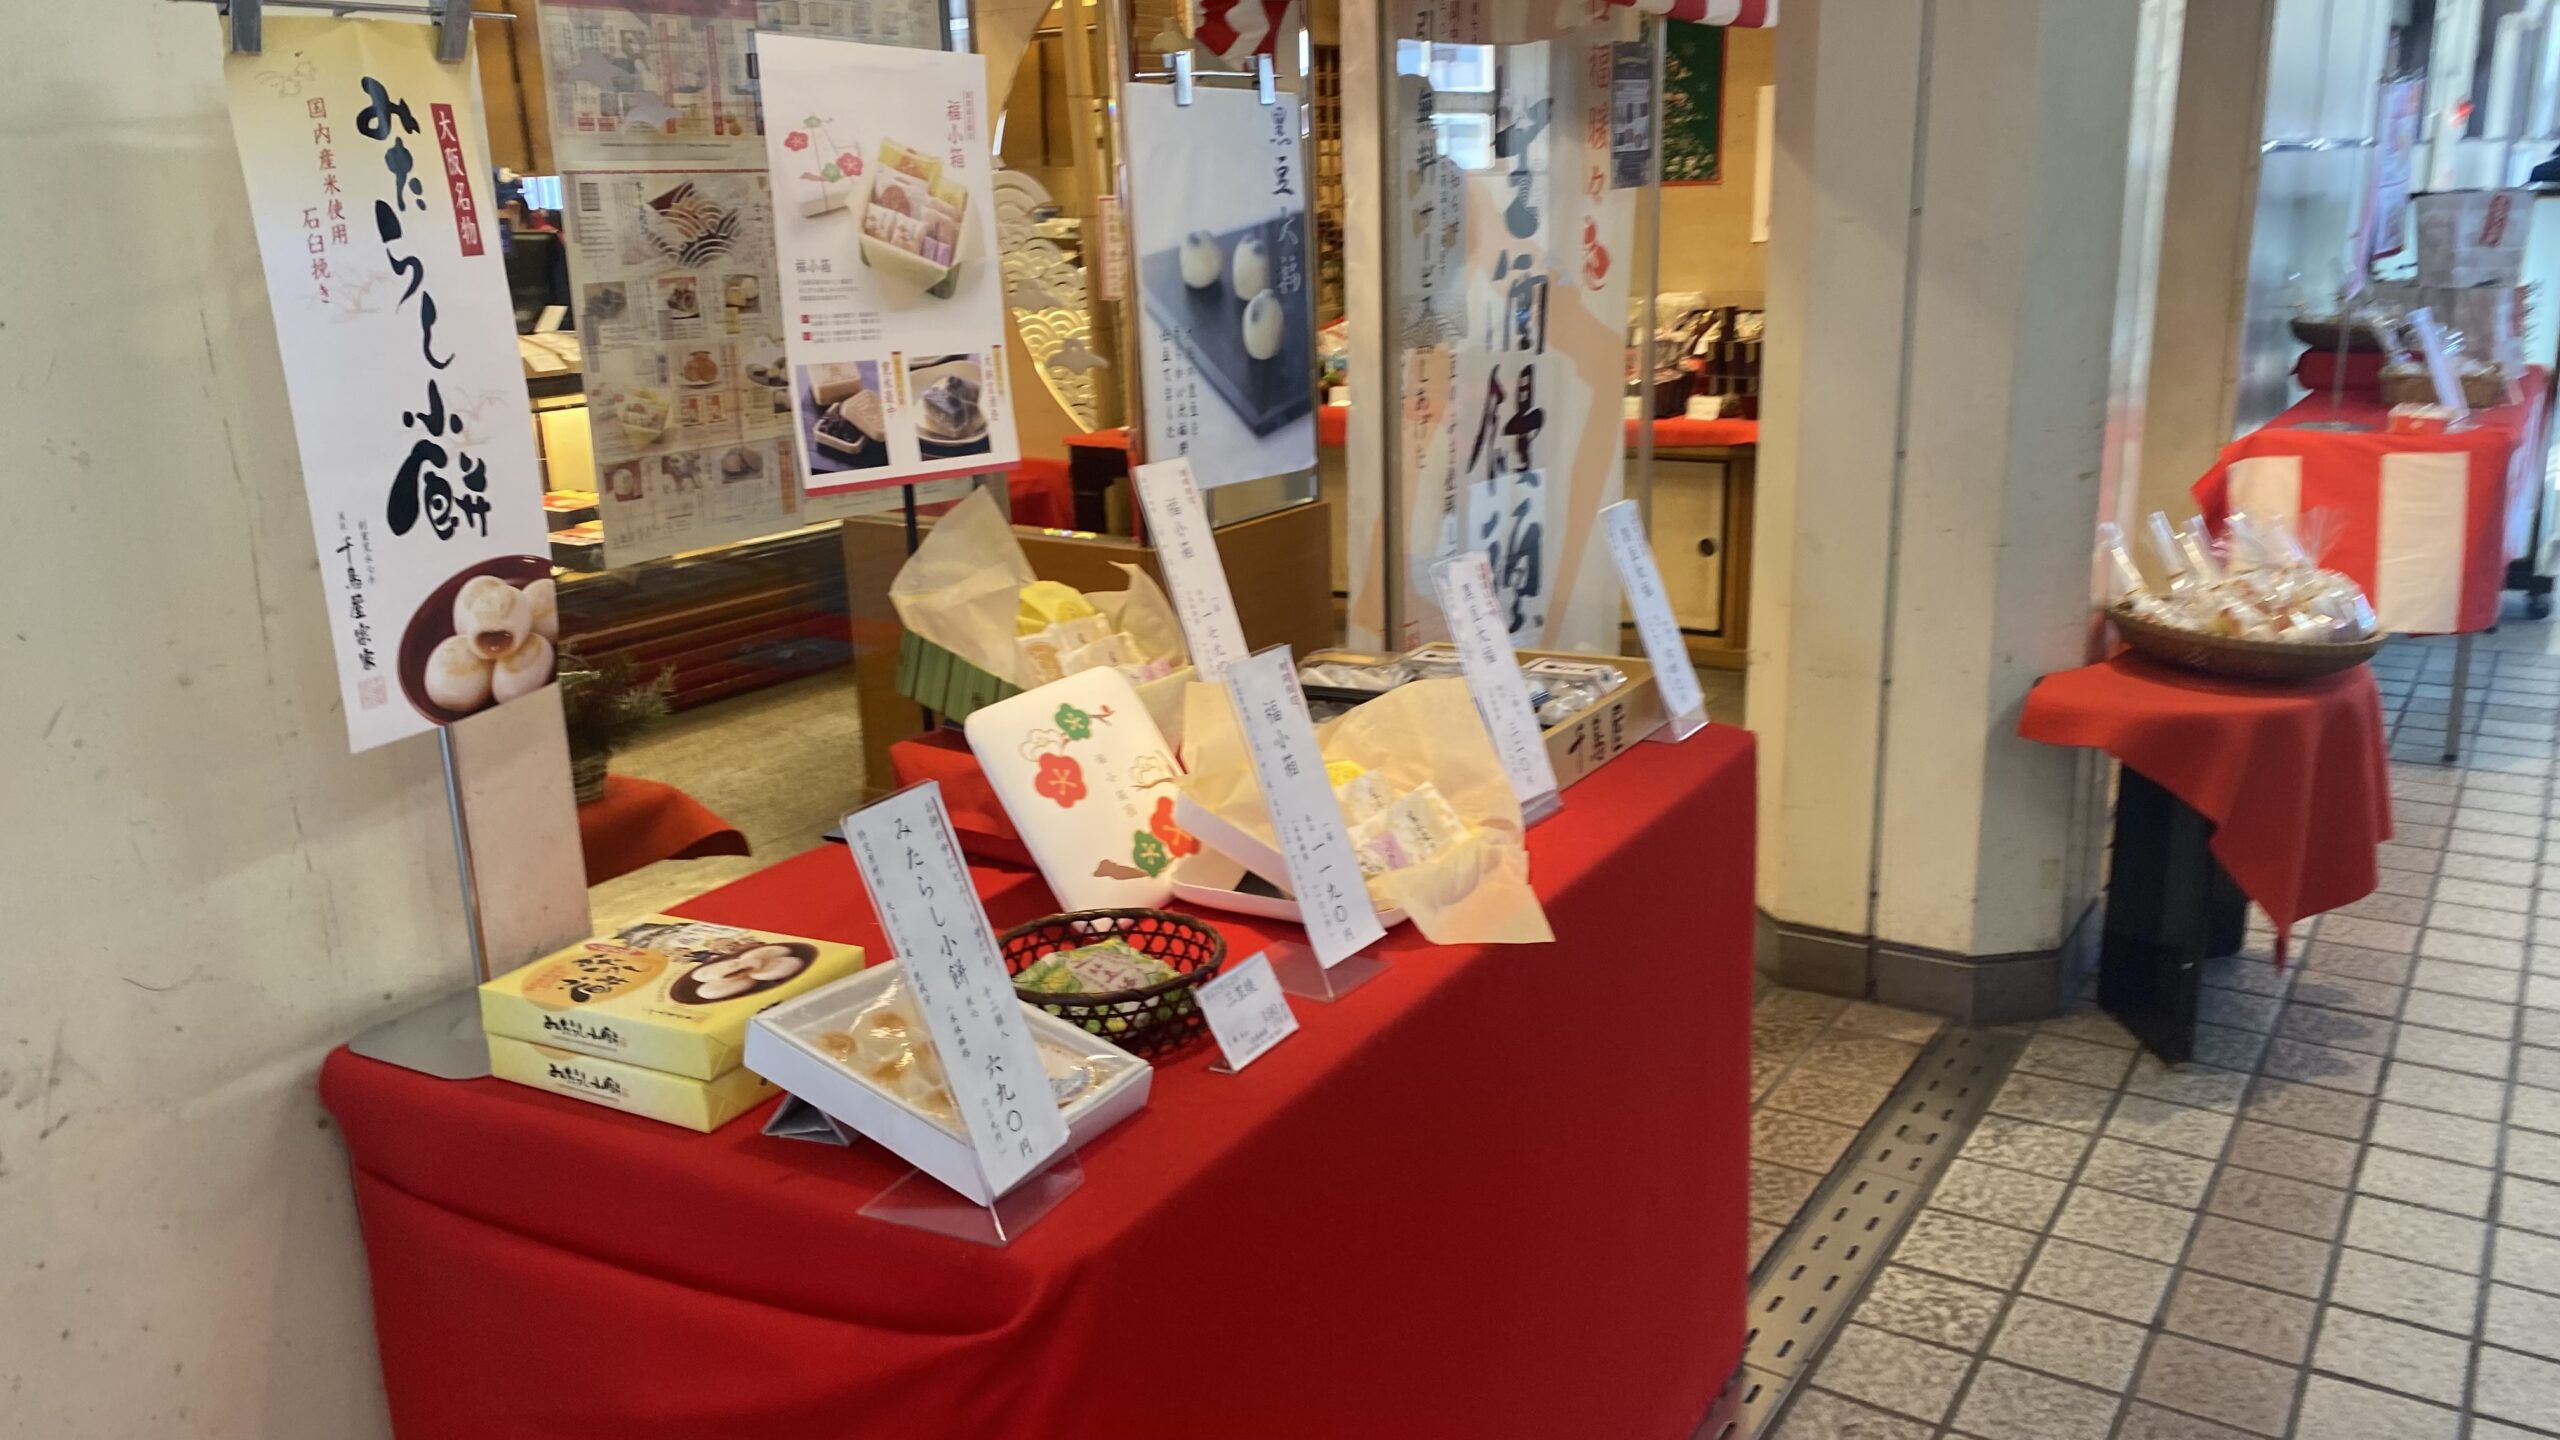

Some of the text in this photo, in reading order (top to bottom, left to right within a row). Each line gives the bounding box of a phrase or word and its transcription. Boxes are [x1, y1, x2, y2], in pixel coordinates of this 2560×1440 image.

[307, 97, 349, 246] 国内産米使用
[438, 109, 478, 247] 大阪名物
[302, 206, 331, 304] 石臼挽き
[356, 76, 491, 541] みたらし小餅
[893, 817, 971, 990] みたらし小餅
[985, 1053, 1034, 1157] 六九〇円
